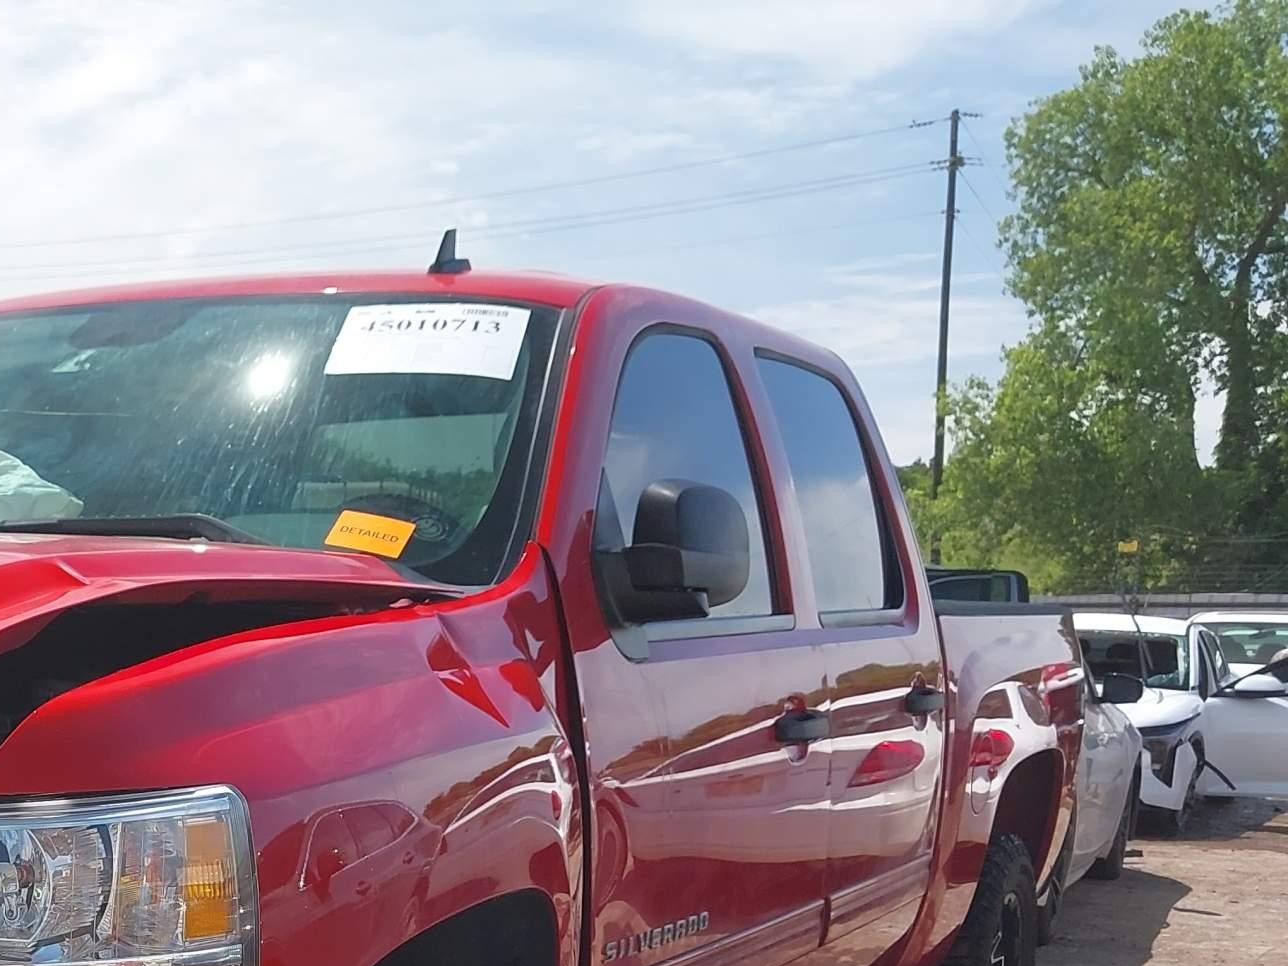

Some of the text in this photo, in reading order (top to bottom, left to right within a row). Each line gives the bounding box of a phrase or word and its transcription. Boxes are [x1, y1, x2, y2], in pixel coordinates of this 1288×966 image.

[361, 319, 501, 334] 45010713
[340, 525, 399, 543] DETAILED
[604, 911, 709, 962] SILVERADO
